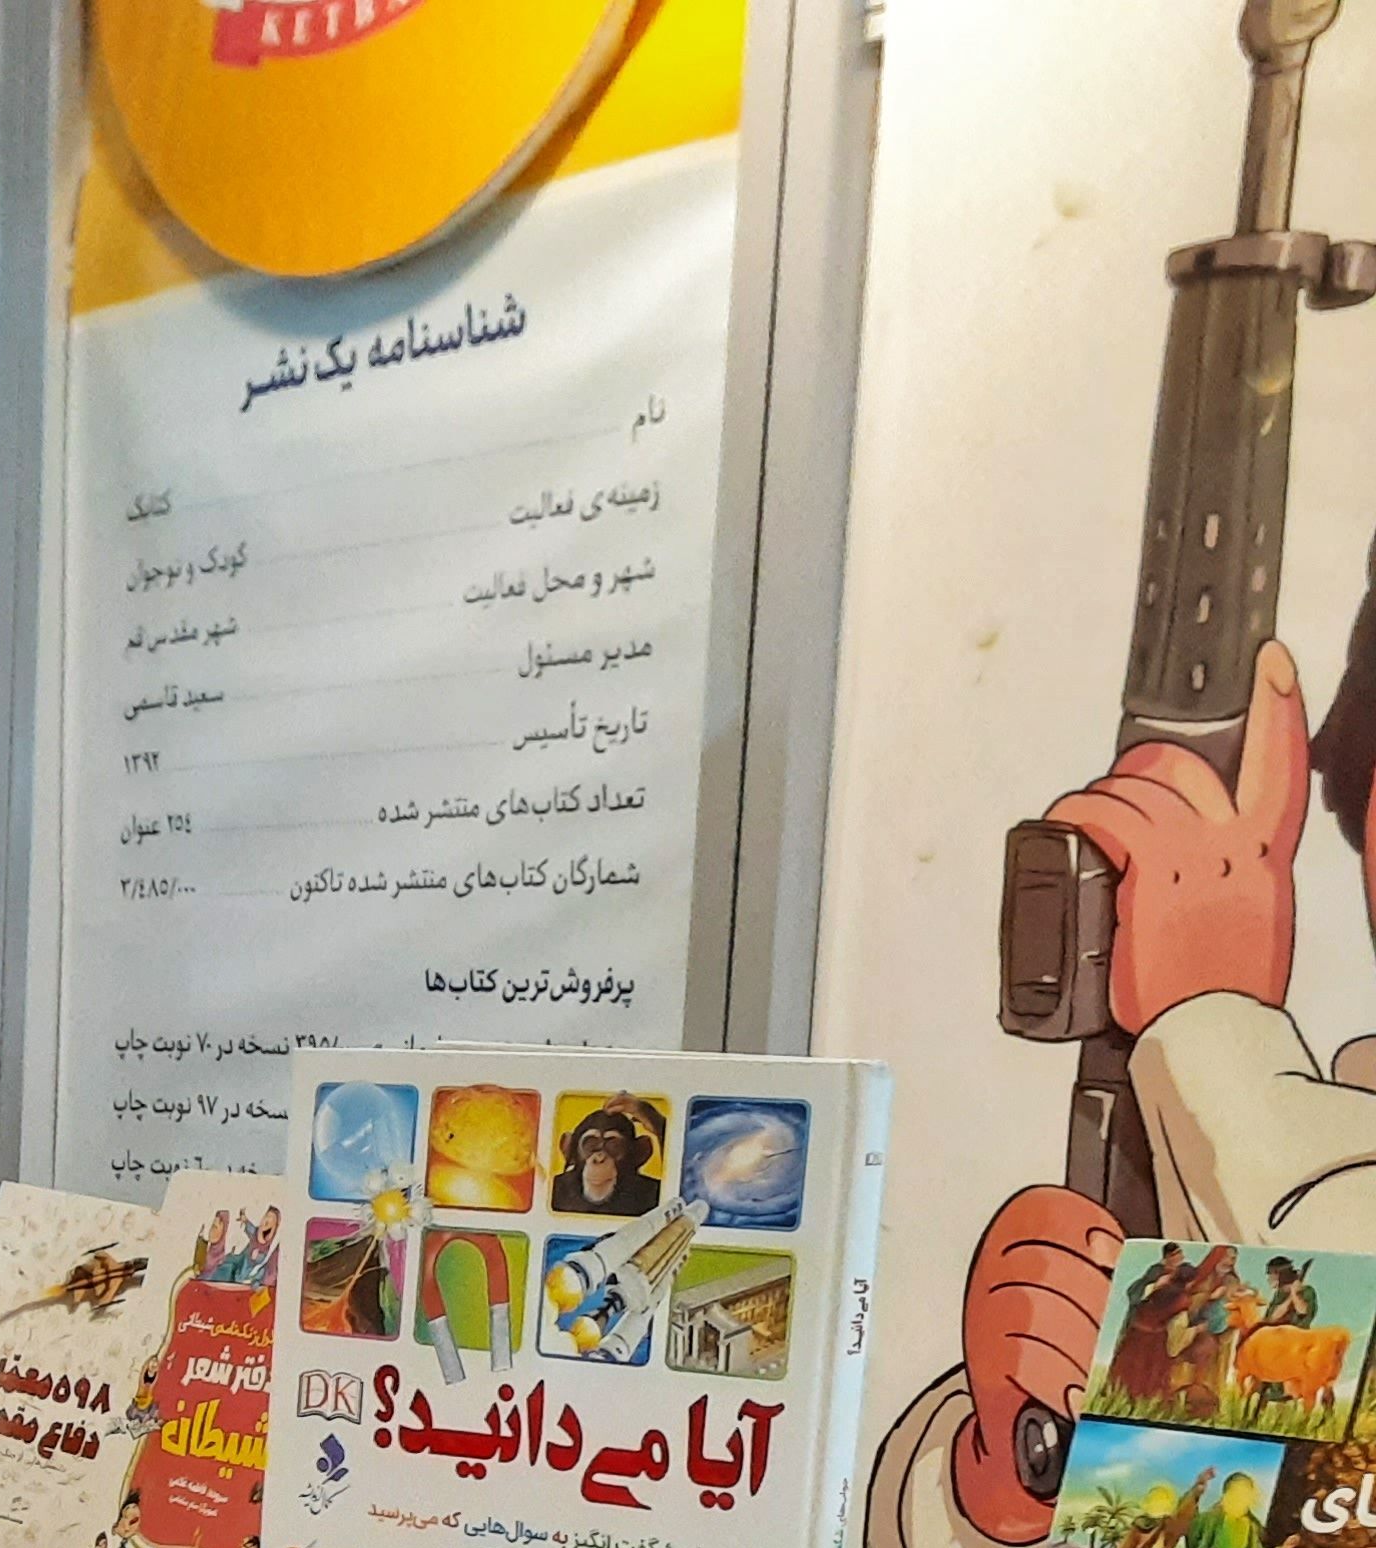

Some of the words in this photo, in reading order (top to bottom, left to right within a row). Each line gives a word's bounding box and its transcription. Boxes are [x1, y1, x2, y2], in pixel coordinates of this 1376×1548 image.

[368, 294, 528, 369] شناسنامه
[240, 347, 309, 412] نشر
[313, 335, 360, 393] یک
[632, 394, 666, 443] نام
[509, 488, 575, 529] فعالیت
[126, 558, 182, 592] نوجوان
[186, 562, 194, 585] و
[199, 540, 247, 578] کودک
[608, 556, 656, 594] شهر
[463, 568, 526, 609] فعالیت
[532, 566, 586, 602] محل
[590, 571, 603, 598] و
[518, 640, 593, 678] مسئول
[600, 640, 653, 670] مدیر
[513, 700, 587, 750] تأسیس
[593, 705, 648, 753] تاریخ
[378, 800, 419, 822] شده
[424, 797, 479, 828] منتشر
[587, 784, 645, 813] تعداد
[120, 814, 160, 845] عنوان
[290, 867, 343, 903] تاکنون
[348, 871, 388, 893] شده
[391, 869, 447, 899] منتشر
[552, 855, 640, 896] شمارگان
[115, 1027, 148, 1060] چاپ
[152, 1035, 191, 1060] نوبت
[216, 1039, 233, 1061] در
[238, 1033, 290, 1055] نسخه
[113, 1088, 147, 1120] چاپ
[152, 1097, 191, 1122] نوبت
[221, 1102, 239, 1124] در
[246, 1098, 288, 1120] سخه
[111, 1150, 144, 1181] چاپ
[181, 1345, 232, 1388] شعر
[305, 1373, 356, 1416] DK
[38, 1420, 100, 1460] دفاع
[161, 1399, 269, 1480] شیطان
[687, 1394, 785, 1511] آیا
[441, 1512, 462, 1527] که
[552, 1531, 569, 1548] به
